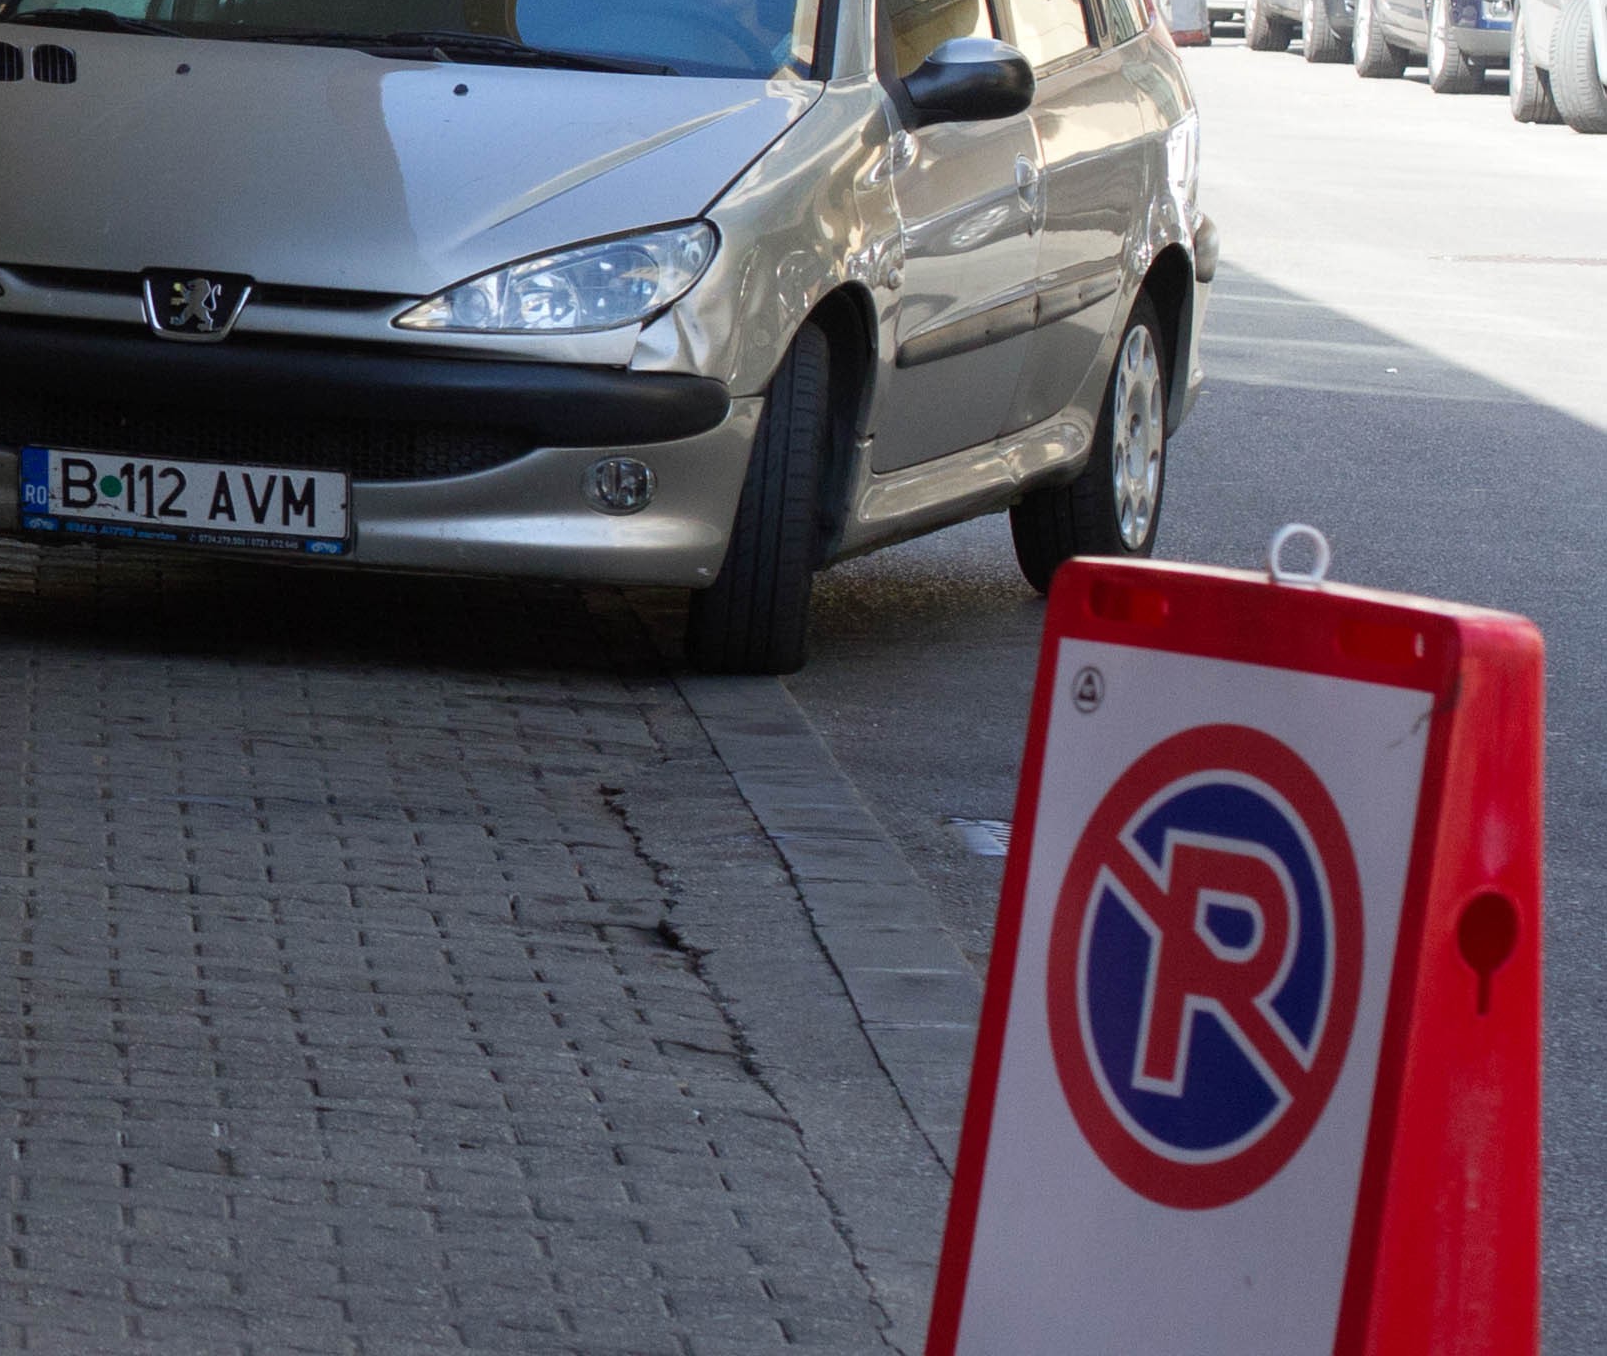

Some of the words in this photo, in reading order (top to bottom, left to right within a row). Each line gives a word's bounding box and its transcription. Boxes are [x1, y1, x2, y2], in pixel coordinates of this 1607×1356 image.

[26, 484, 47, 506] RO
[61, 458, 98, 509] B
[120, 462, 187, 519] 112
[208, 470, 315, 527] AVM
